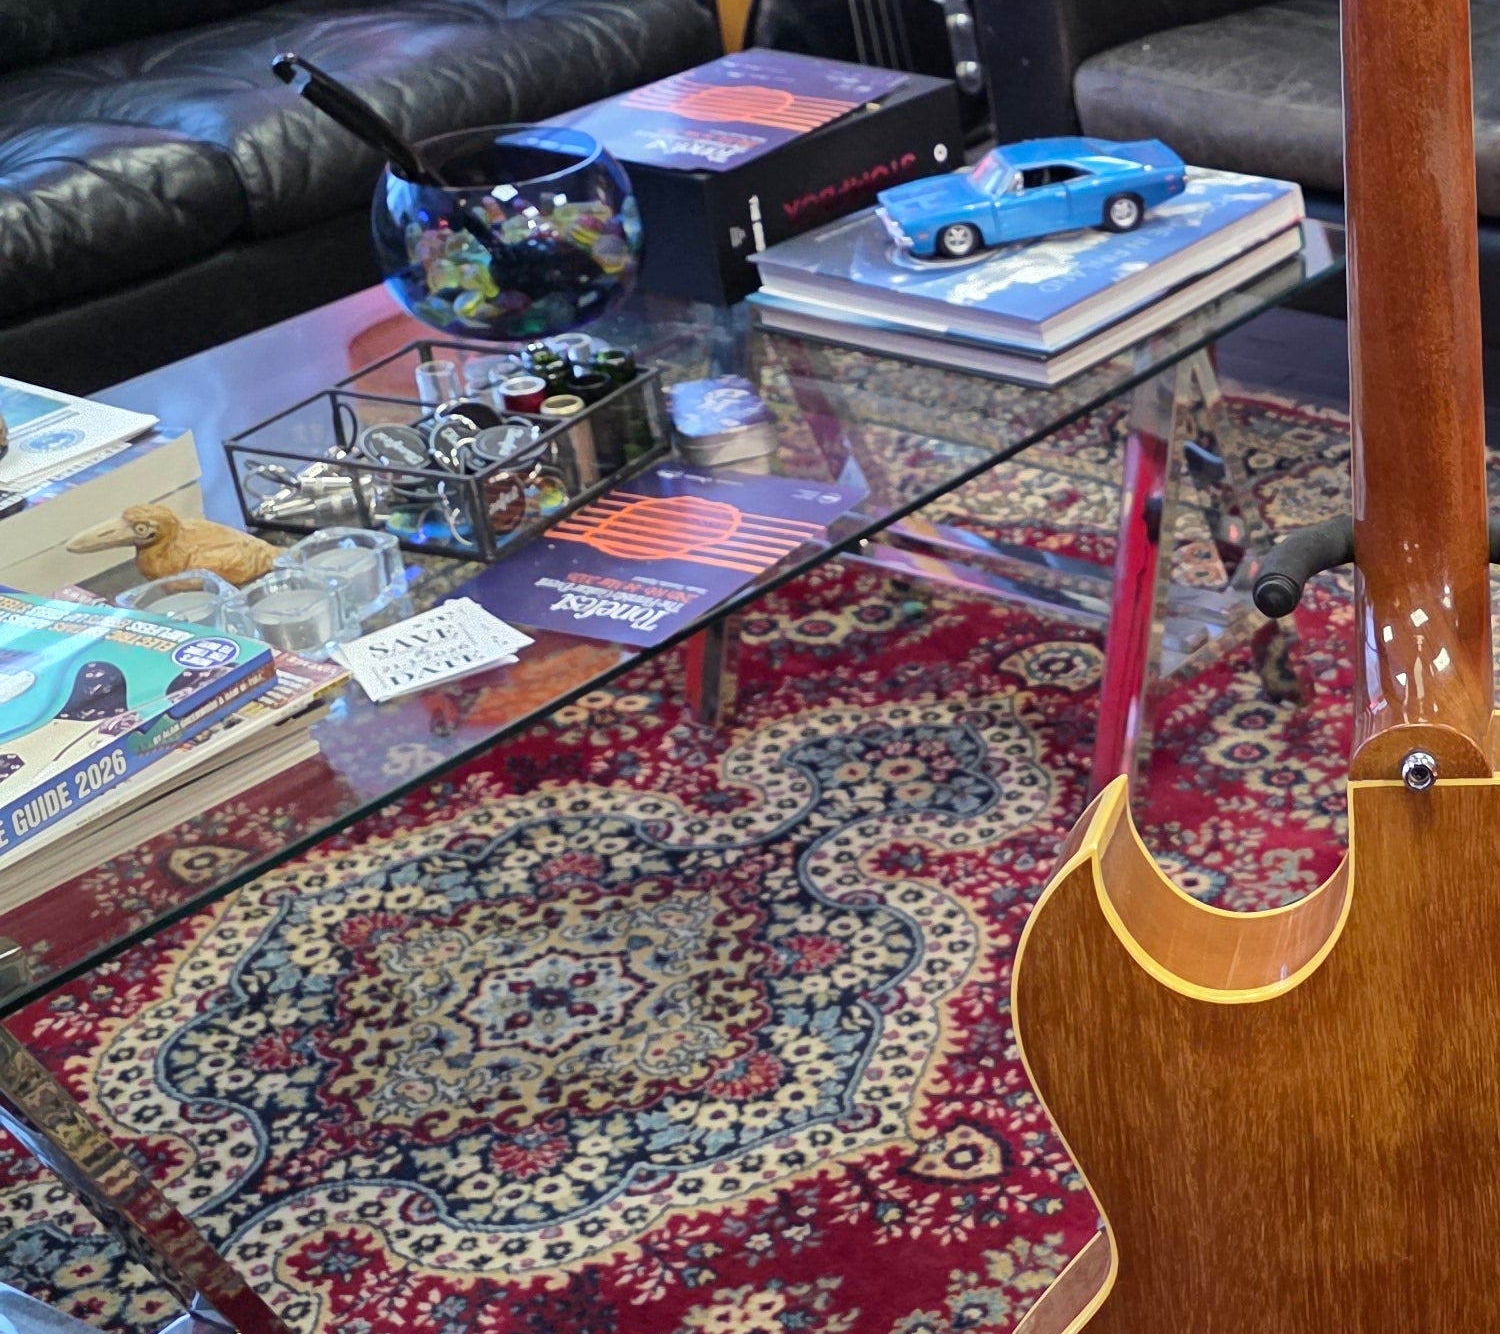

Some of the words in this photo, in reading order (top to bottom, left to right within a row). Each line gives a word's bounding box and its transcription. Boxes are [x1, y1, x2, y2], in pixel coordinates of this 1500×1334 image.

[549, 593, 667, 632] Tonefest
[11, 781, 73, 836] GUIDE
[75, 749, 127, 799] 2026
